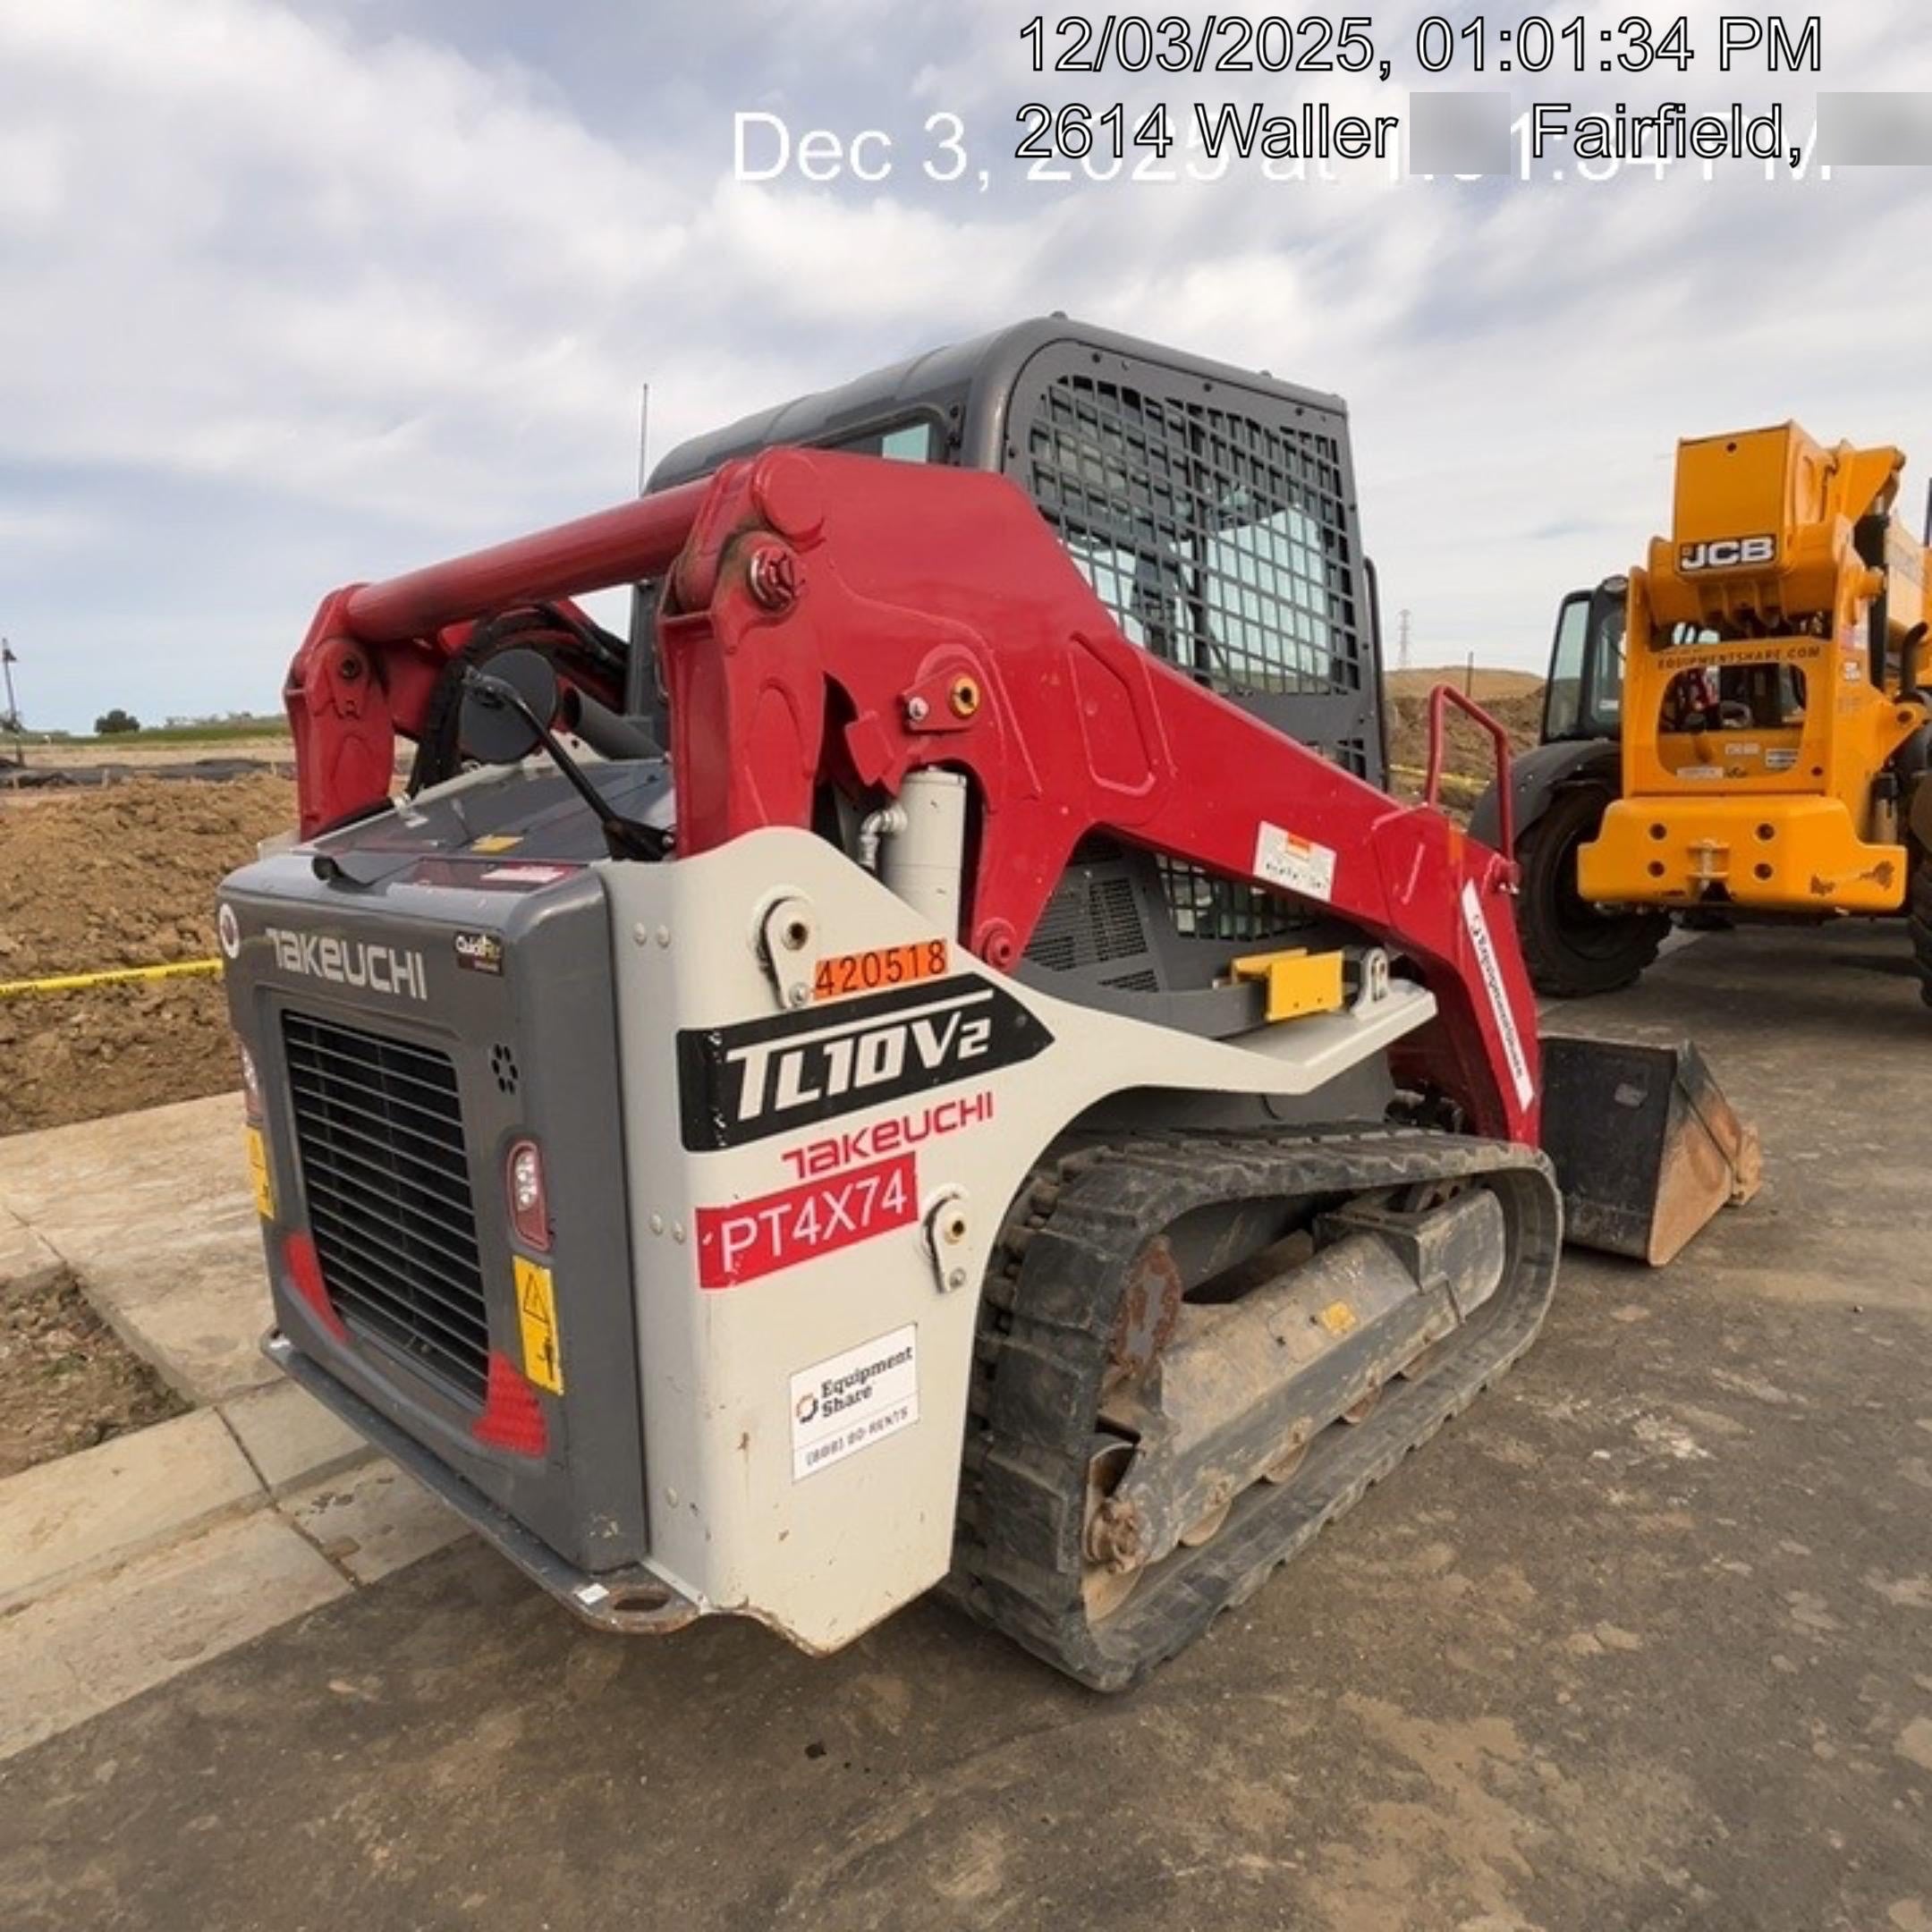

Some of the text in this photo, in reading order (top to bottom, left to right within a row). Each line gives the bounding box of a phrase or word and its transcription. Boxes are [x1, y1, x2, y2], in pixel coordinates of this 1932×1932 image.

[1681, 537, 1774, 570] JCB
[815, 939, 946, 992] 420518
[719, 1169, 908, 1273] PT4X74
[820, 1346, 913, 1399] Equipment
[820, 1384, 874, 1418] Share
